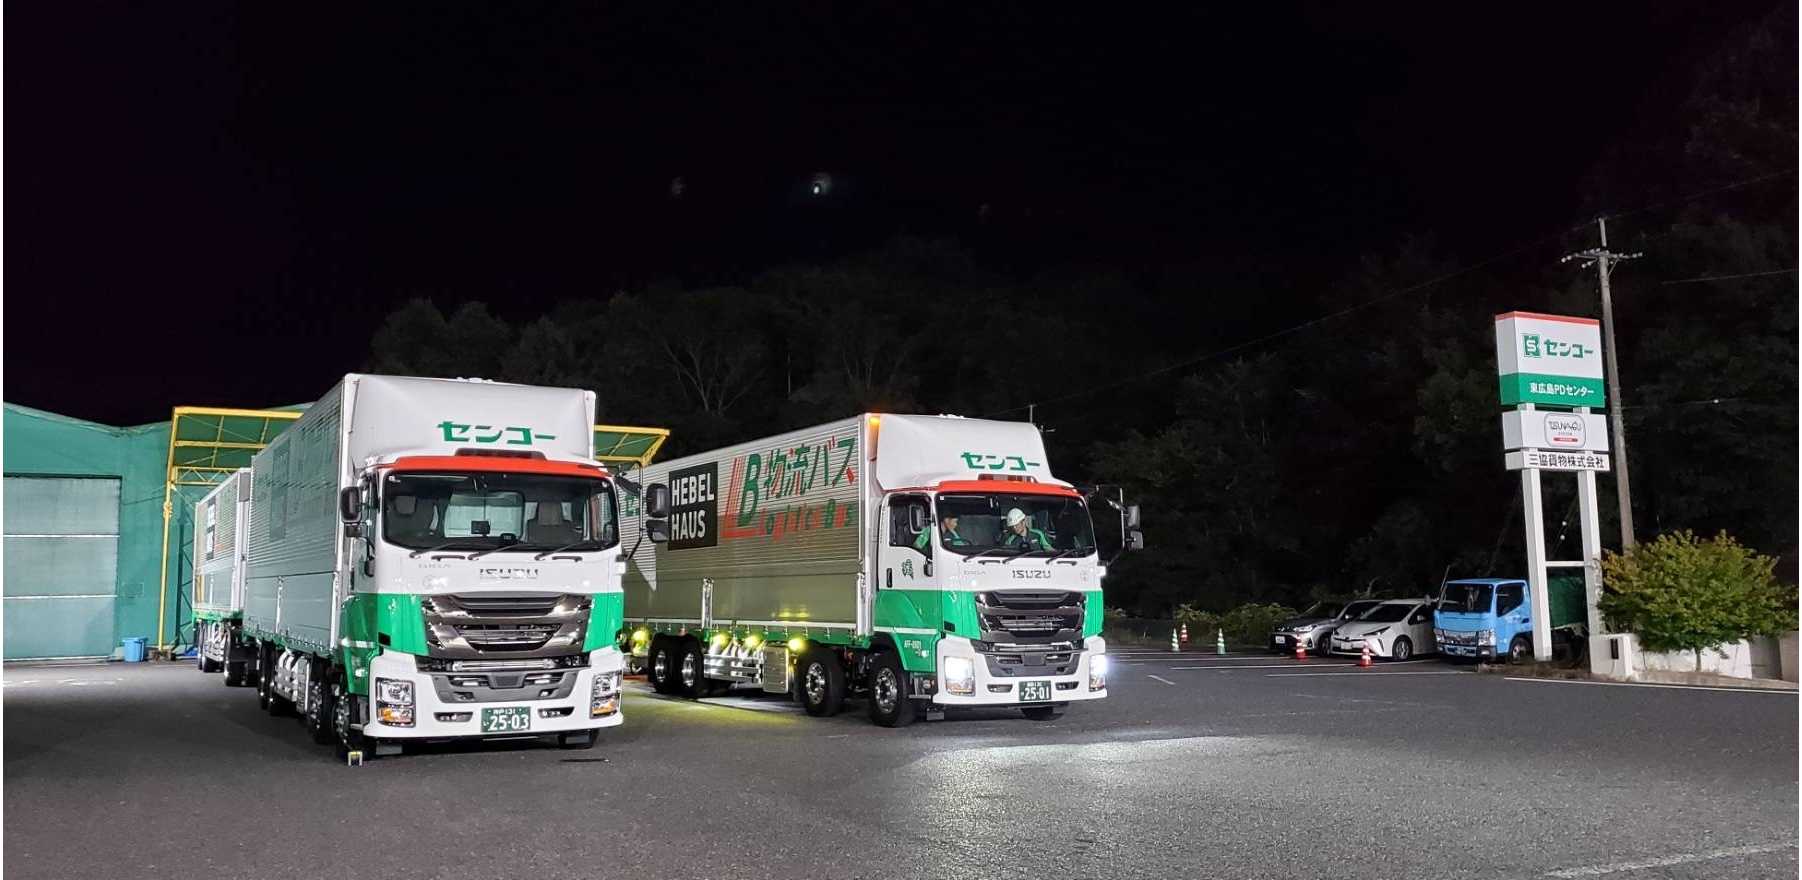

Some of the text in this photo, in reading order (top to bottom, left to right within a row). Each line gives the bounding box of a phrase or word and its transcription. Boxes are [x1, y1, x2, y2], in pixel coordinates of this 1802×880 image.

[1544, 339, 1594, 359] センコー
[1529, 382, 1595, 397] 東広島PDセンター
[437, 421, 556, 445] センコー
[764, 436, 856, 500] 物流バス
[961, 452, 1040, 471] センコー
[671, 473, 714, 507] HEBEL
[671, 510, 706, 541] HAUS
[1012, 569, 1051, 579] ISUZU
